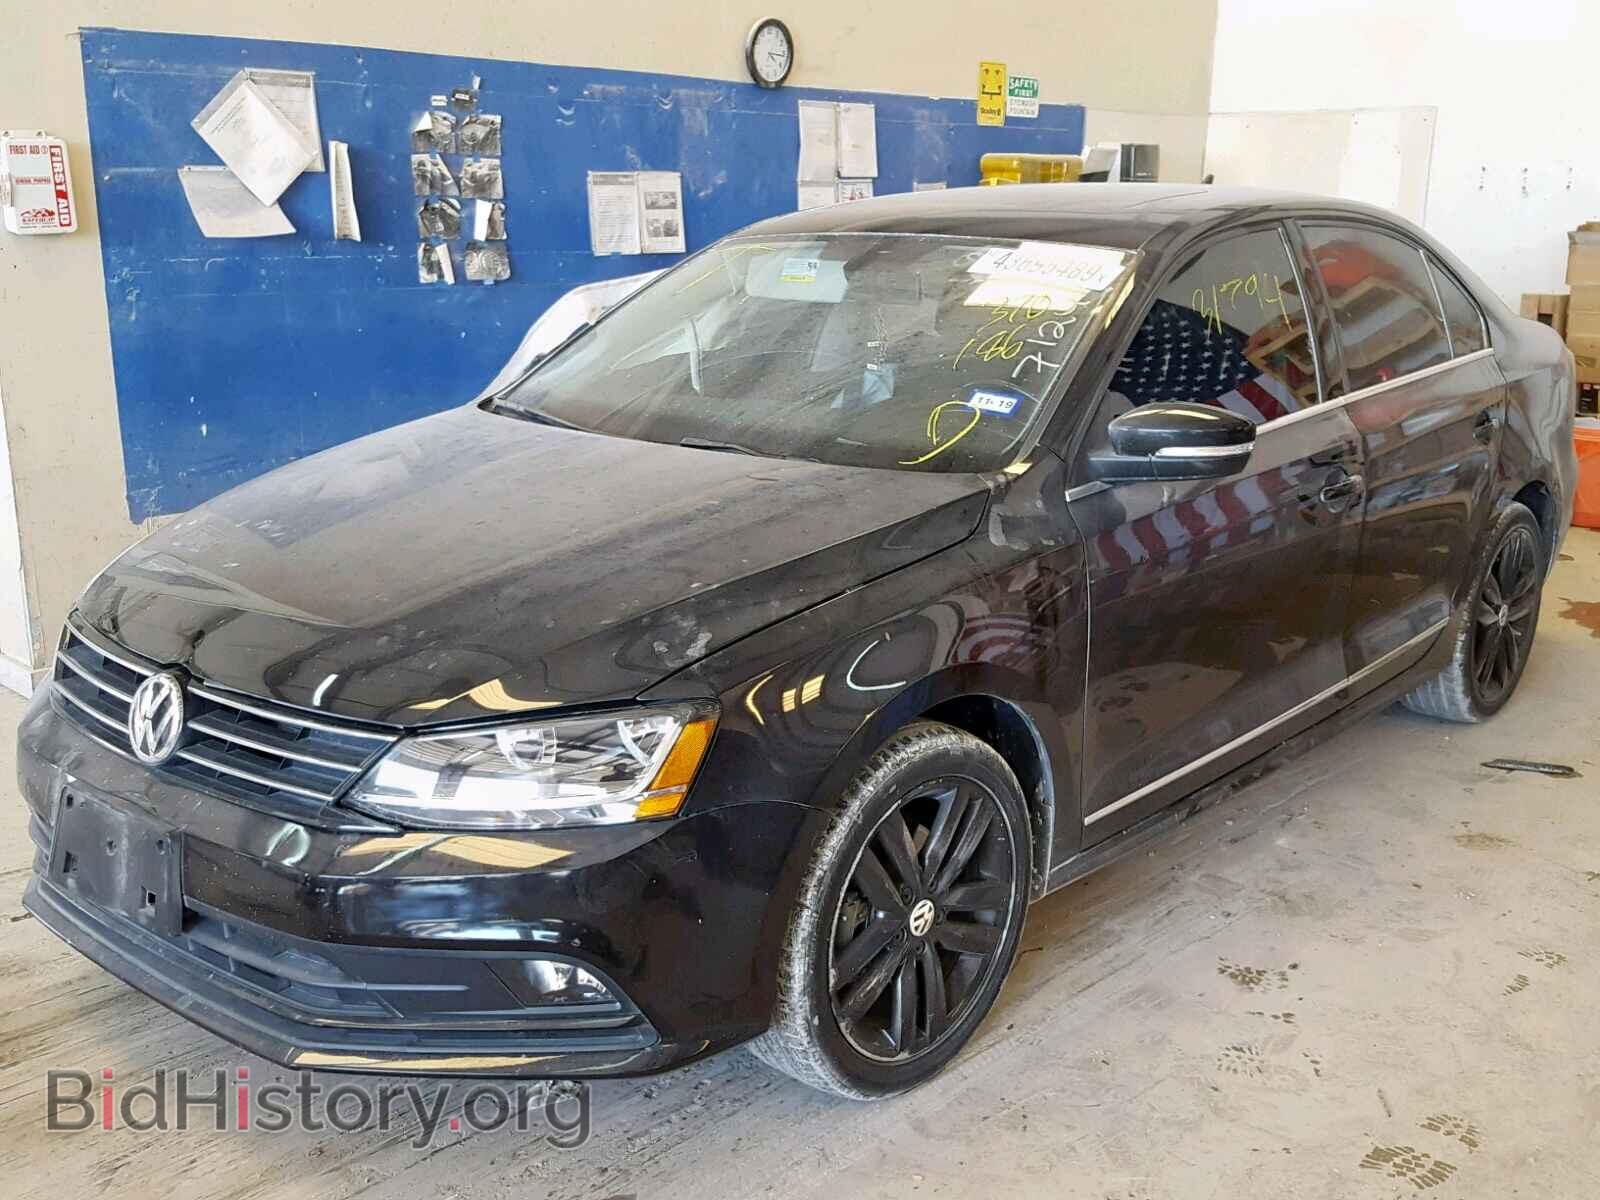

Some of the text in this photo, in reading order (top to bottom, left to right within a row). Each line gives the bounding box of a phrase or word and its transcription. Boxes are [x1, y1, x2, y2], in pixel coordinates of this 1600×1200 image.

[9, 145, 40, 155] FIRST AID
[51, 146, 71, 225] FIRST AID
